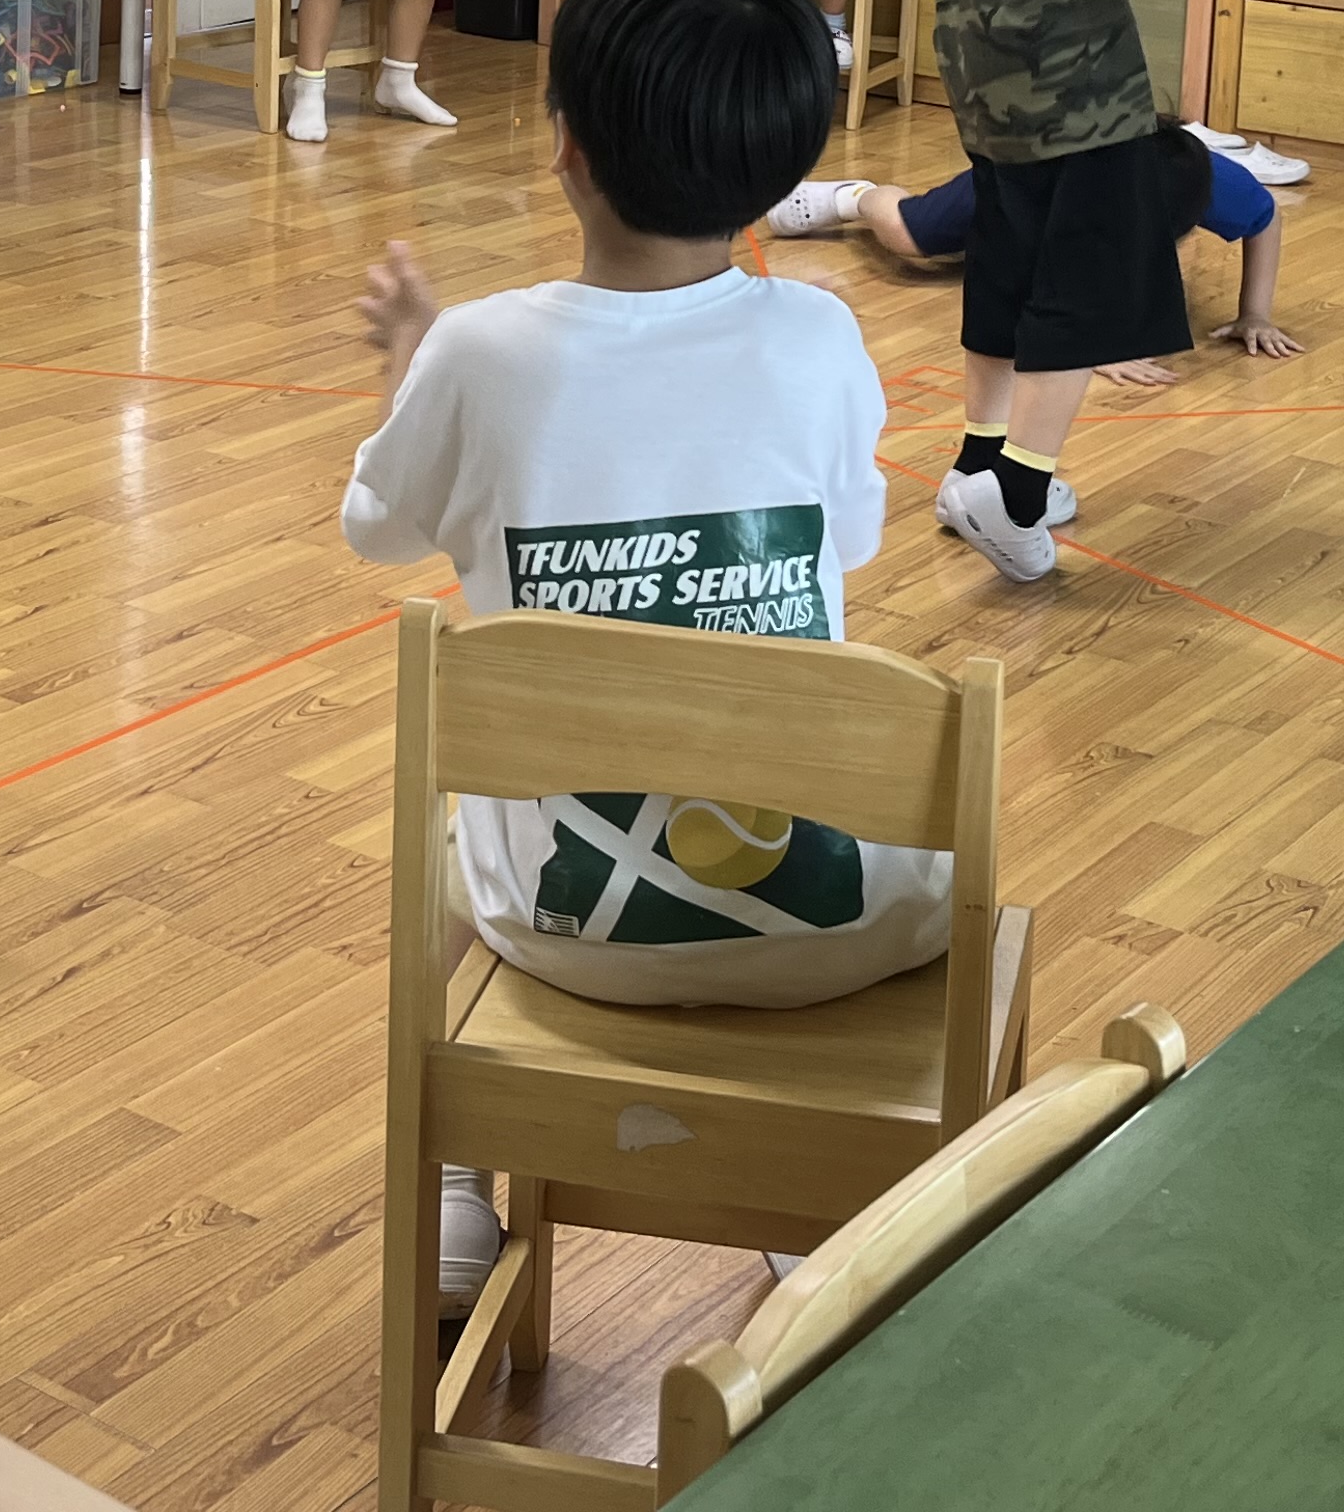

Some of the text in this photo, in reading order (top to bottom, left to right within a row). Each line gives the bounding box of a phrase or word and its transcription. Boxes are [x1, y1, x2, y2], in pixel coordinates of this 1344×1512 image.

[517, 529, 701, 575] TFUNKIDS
[518, 554, 815, 613] SPORTS SERVICE
[694, 593, 814, 635] TENNIS
